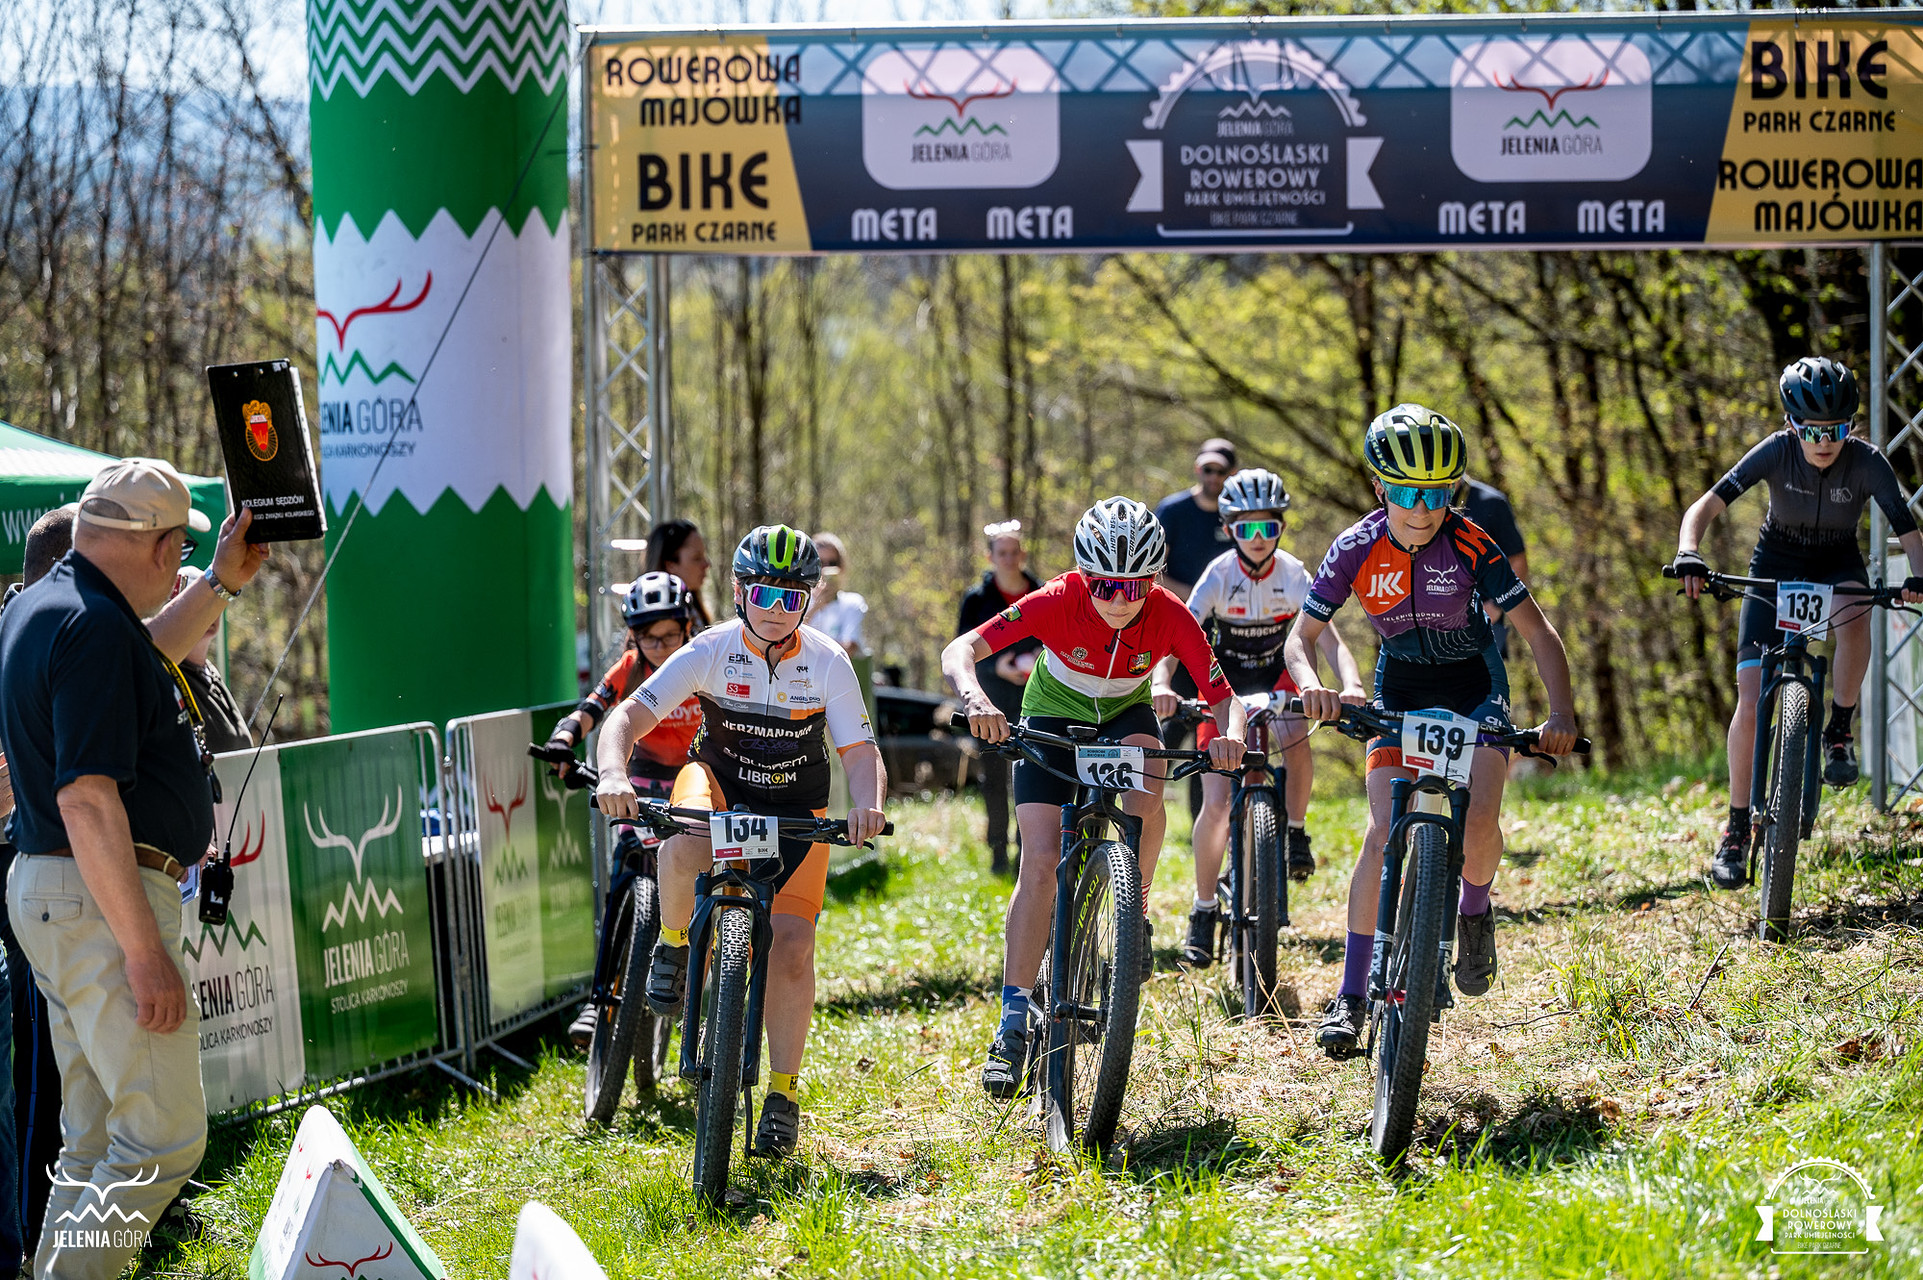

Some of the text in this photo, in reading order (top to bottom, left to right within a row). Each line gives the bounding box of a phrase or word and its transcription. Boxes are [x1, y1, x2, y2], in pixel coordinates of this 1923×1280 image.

[606, 53, 801, 86] ROWEROWA
[1751, 40, 1888, 99] BIKE
[640, 87, 801, 127] MAJÓWKA
[1743, 109, 1896, 133] PARK CZARNE
[911, 142, 970, 163] JELENIA
[1180, 141, 1330, 166] DOLNOŚLĄSKI
[1500, 135, 1560, 156] JELENIA
[638, 151, 770, 212] BIKE
[1190, 167, 1321, 189] ROWEROWY
[1718, 157, 1923, 191] ROWEROWA
[851, 205, 1074, 242] META META
[1438, 199, 1665, 235] META META
[1754, 191, 1923, 232] MAJÓWKA
[631, 221, 777, 244] PARK CZARNE
[356, 393, 424, 435] GÓRA
[241, 494, 305, 508] KOLEGIUM SĘDZIÓW
[1786, 591, 1824, 624] 133
[1415, 722, 1466, 761] 139
[721, 815, 769, 843] 134
[323, 928, 411, 989] JELENIA GÓRA
[192, 964, 275, 1022] ENIA GÓRA
[219, 1016, 274, 1046] KARKONOSZY
